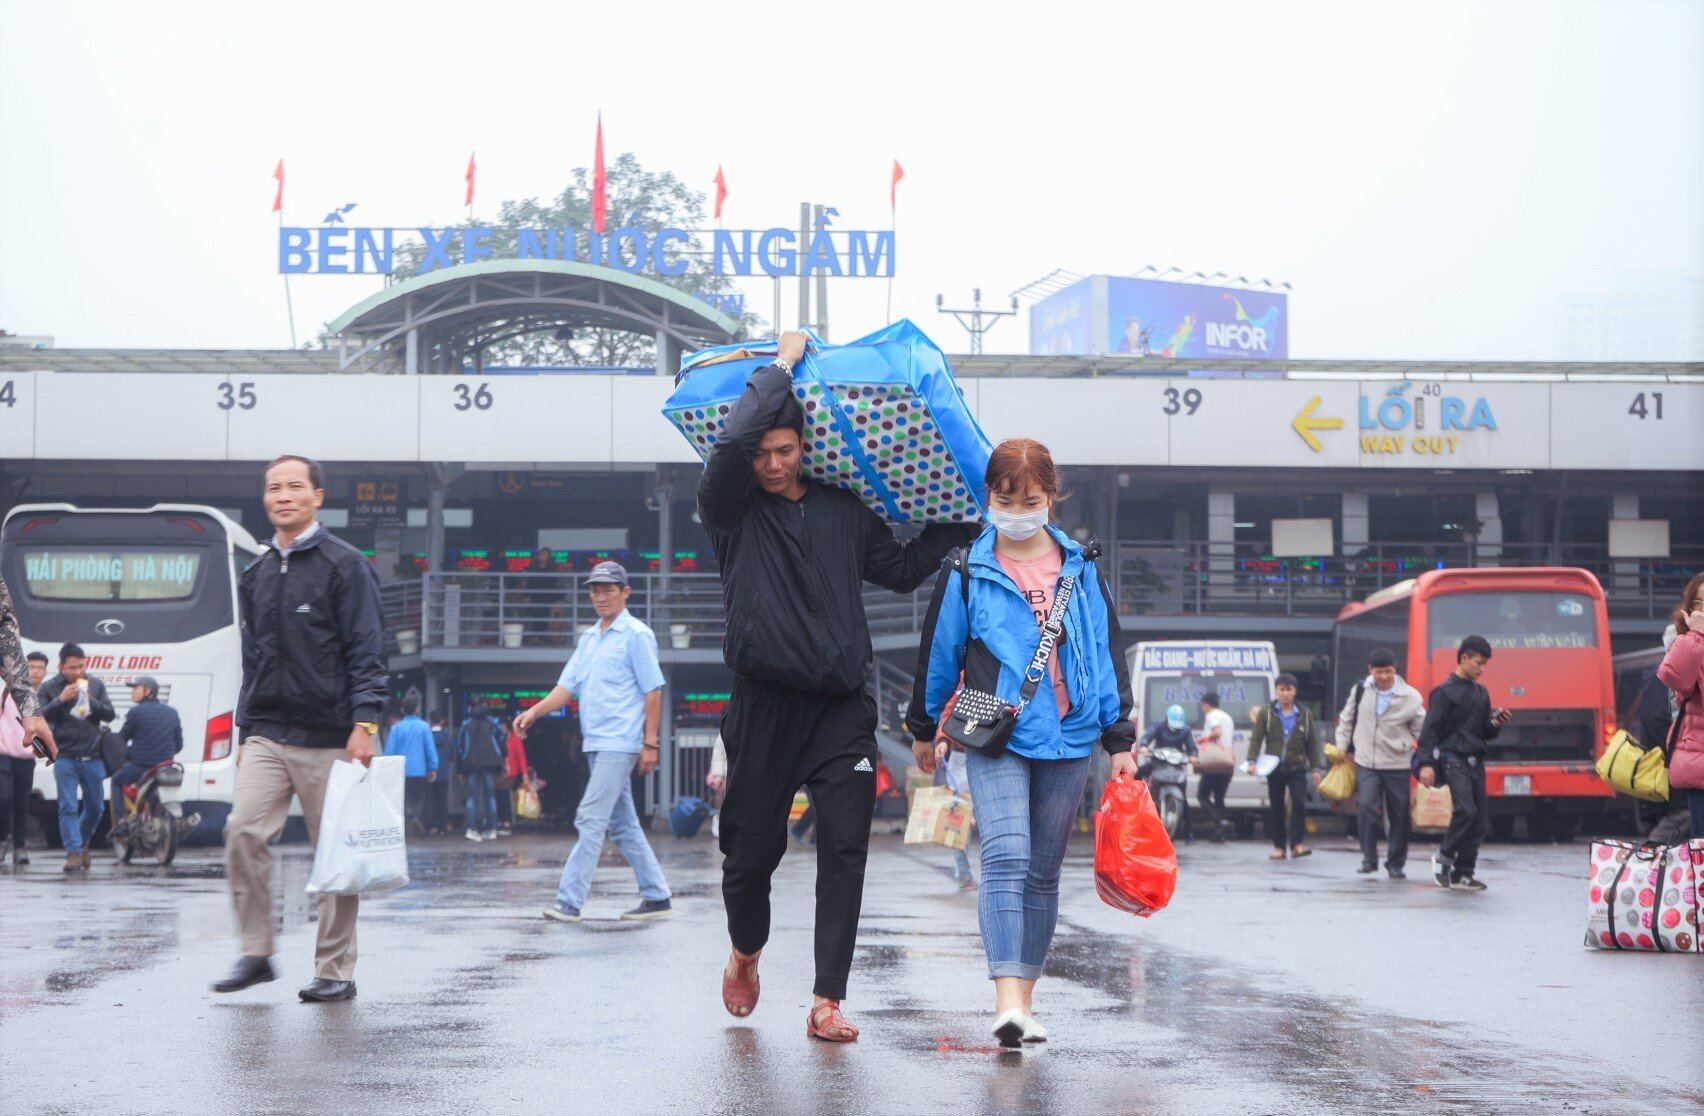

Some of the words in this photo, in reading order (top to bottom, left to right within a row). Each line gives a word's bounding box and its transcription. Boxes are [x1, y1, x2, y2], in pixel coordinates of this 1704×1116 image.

[279, 203, 394, 274] BẾN
[713, 206, 896, 278] NGẦM
[1206, 321, 1268, 352] INFOR
[217, 382, 257, 410] 35
[454, 383, 493, 411] 36
[1162, 387, 1203, 416] 39
[1422, 383, 1442, 397] 40
[1359, 380, 1425, 431] LỐI
[1441, 396, 1498, 431] RA
[1629, 392, 1663, 420] 41
[1359, 435, 1406, 455] WAY
[1412, 436, 1461, 454] OUT
[26, 552, 56, 581] HẢI
[62, 554, 122, 582] PHÒNG
[133, 555, 155, 581] HÀ
[161, 554, 193, 585] NỘI
[117, 656, 162, 670] LONG
